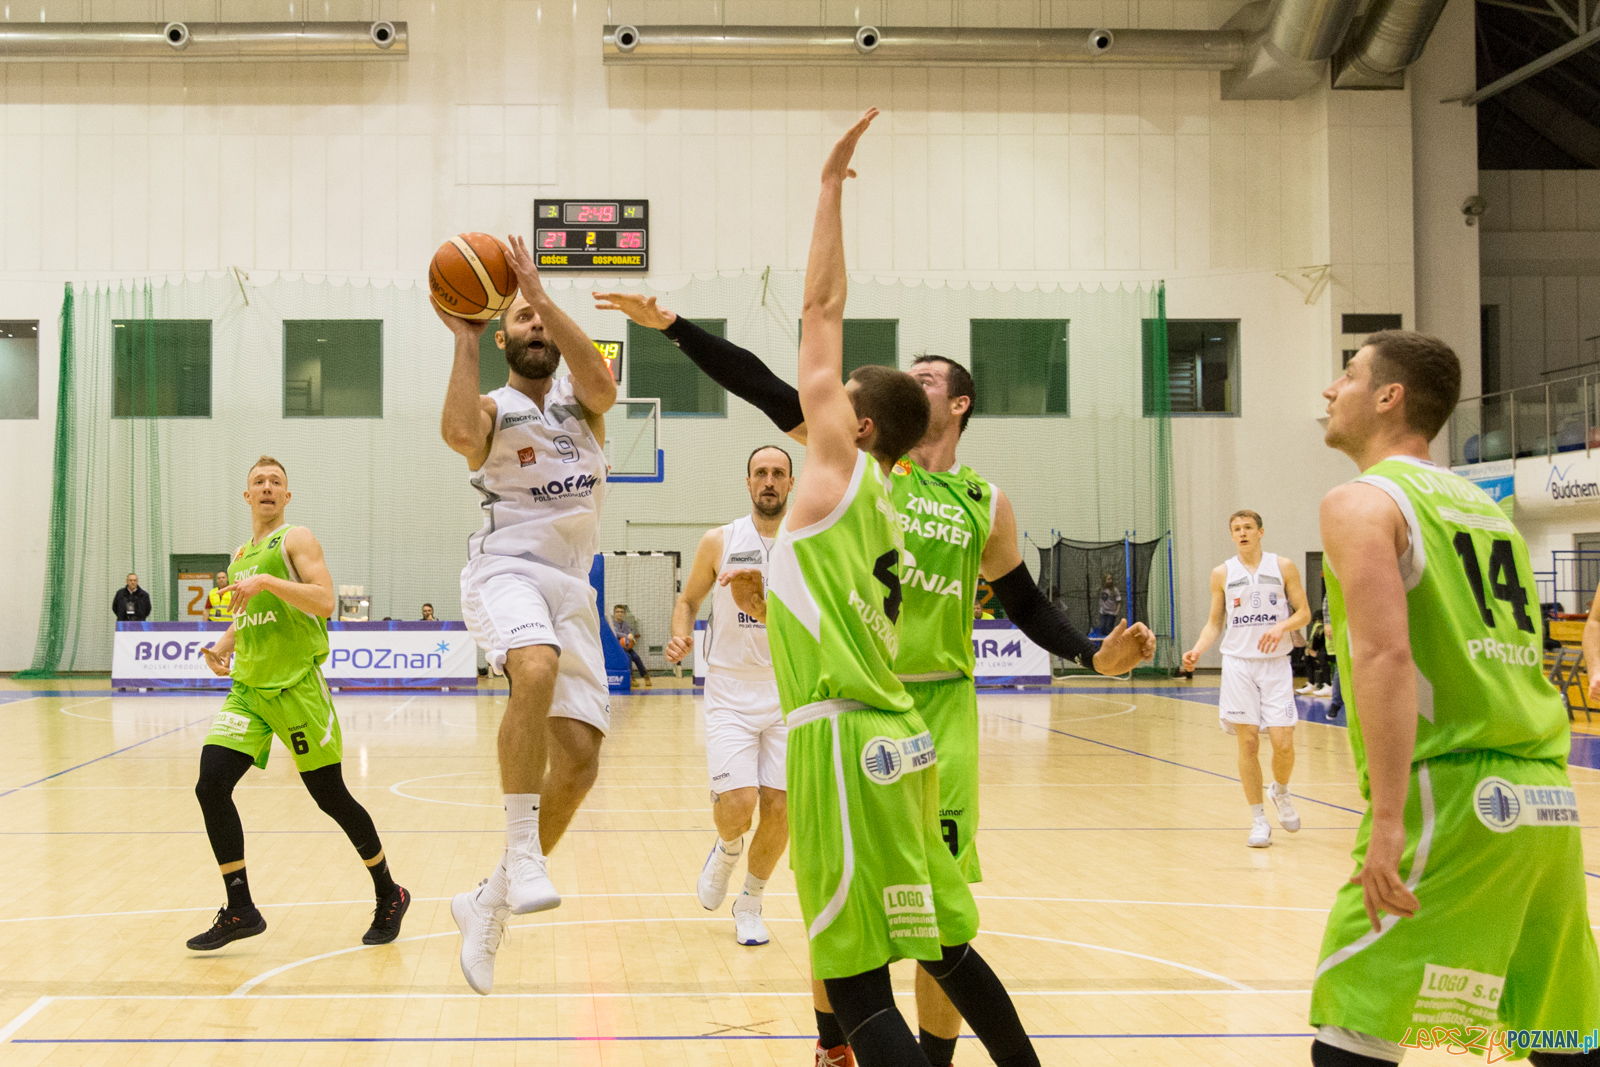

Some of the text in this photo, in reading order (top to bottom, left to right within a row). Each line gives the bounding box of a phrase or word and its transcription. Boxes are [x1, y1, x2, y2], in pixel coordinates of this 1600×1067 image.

[577, 205, 614, 222] 2:49
[543, 231, 567, 248] 27
[585, 231, 596, 245] 2
[618, 231, 641, 248] 26
[541, 254, 569, 265] GOŚCIE
[592, 255, 641, 265] GOSPODARZE
[553, 435, 580, 464] 9
[1551, 481, 1600, 500] Budchem
[899, 513, 972, 549] BASKET
[1452, 531, 1536, 634] 14
[187, 586, 204, 616] 2
[1251, 591, 1261, 609] 6
[1233, 614, 1277, 625] BIOFARM
[290, 731, 310, 755] 6
[940, 819, 958, 857] 9
[888, 890, 925, 908] LOGO
[1428, 972, 1469, 992] LOGO
